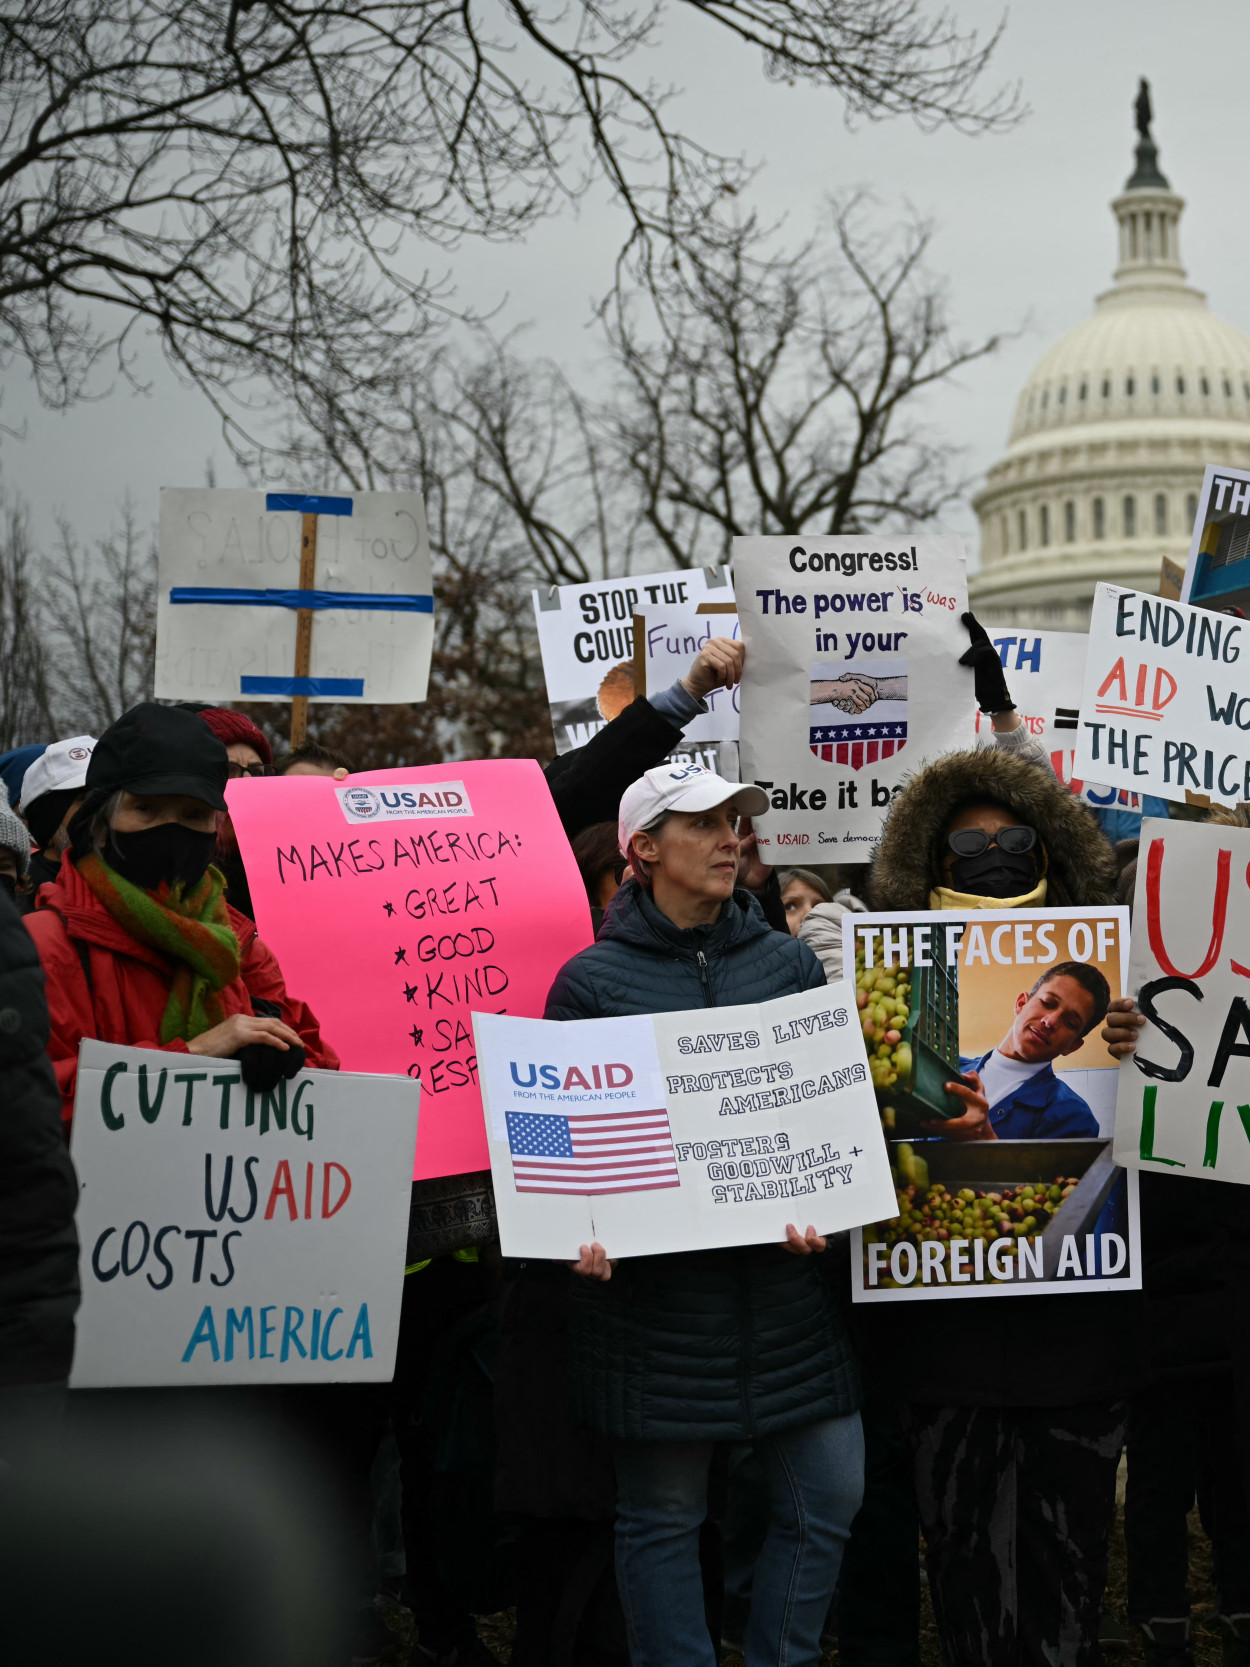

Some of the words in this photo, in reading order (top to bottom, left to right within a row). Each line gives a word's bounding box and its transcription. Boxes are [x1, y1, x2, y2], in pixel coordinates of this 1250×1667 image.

[789, 546, 918, 576] Congress!
[579, 588, 638, 624] STOP
[756, 589, 807, 616] The
[814, 590, 894, 619] power
[816, 628, 838, 652] in
[845, 631, 908, 660] your
[1116, 594, 1242, 664] ENDING
[1097, 656, 1178, 710] AID
[1083, 722, 1152, 776] THE
[380, 791, 463, 808] USAID
[838, 780, 858, 809] it
[276, 839, 385, 884] MAKES
[394, 830, 522, 868] AMERICA:
[405, 877, 498, 919] GREAT
[417, 927, 494, 962] GOOD
[857, 926, 933, 969] THE
[946, 921, 1058, 966] FACES
[1067, 922, 1115, 962] OF
[426, 965, 509, 1009] KIND
[678, 1030, 760, 1054] SAVES
[773, 1008, 848, 1044] LIVES
[510, 1062, 633, 1090] USAID
[514, 1091, 536, 1099] FROM
[538, 1093, 555, 1101] THE
[557, 1093, 602, 1102] AMERICAN
[605, 1091, 636, 1099] PEOPLE
[666, 1061, 793, 1094] PROTECTS
[719, 1063, 866, 1115] AMERICANS
[100, 1062, 314, 1141] CUTTING
[676, 1132, 790, 1161] FOSTERS
[707, 1143, 840, 1181] GOODWILL
[204, 1153, 352, 1224] USAID
[711, 1164, 852, 1204] STABILITY
[92, 1221, 242, 1290] COSTS
[867, 1236, 1043, 1286] FOREIGN
[1056, 1232, 1126, 1278] AID
[181, 1302, 373, 1364] AMERICA
